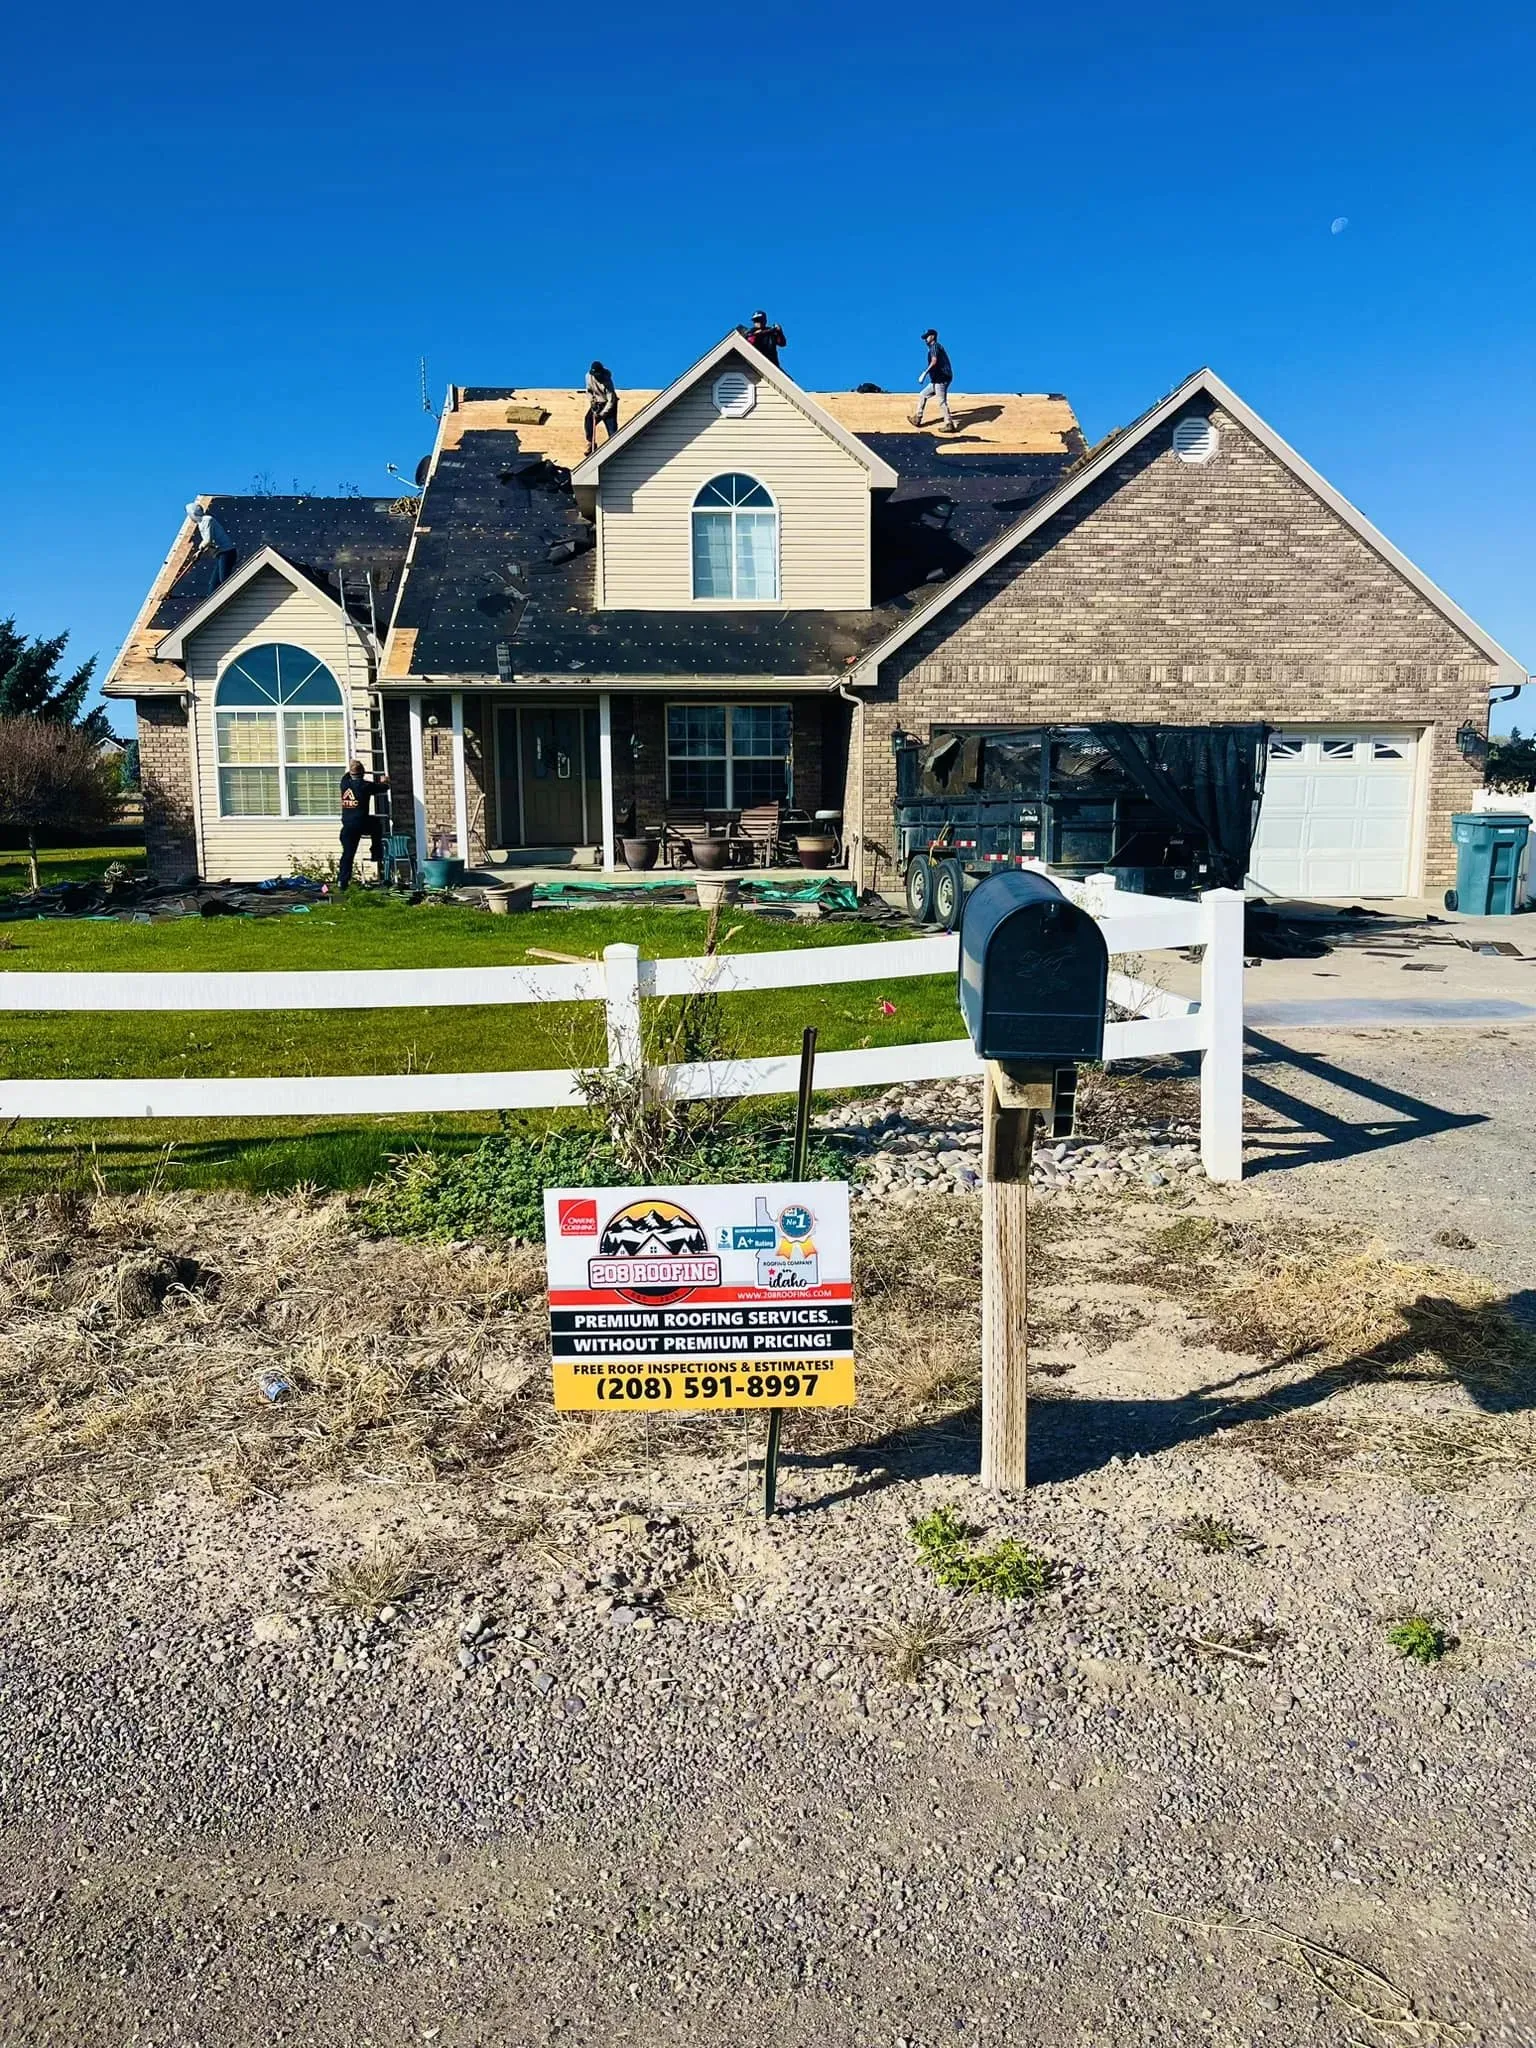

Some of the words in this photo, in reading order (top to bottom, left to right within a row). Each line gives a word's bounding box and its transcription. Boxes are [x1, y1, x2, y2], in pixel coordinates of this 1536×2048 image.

[737, 1236, 754, 1249] A+
[592, 1264, 630, 1284] 208
[633, 1262, 718, 1283] ROOFING
[737, 1289, 832, 1299] WWW.208ROOFING.COM
[574, 1313, 659, 1328] PREMIUM
[664, 1311, 744, 1327] ROOFING
[748, 1309, 839, 1325] SERVICES...
[573, 1337, 659, 1352] WITHOUT
[663, 1335, 748, 1350] PREMIUM
[753, 1333, 832, 1349] PRICING!
[573, 1364, 604, 1375] FREE
[608, 1363, 644, 1374] ROOF
[648, 1362, 737, 1374] INSPECTIONS
[741, 1361, 750, 1372] &
[754, 1360, 834, 1372] ESTIMATES!
[597, 1377, 673, 1400] (208)
[684, 1374, 819, 1398] 591-8997
